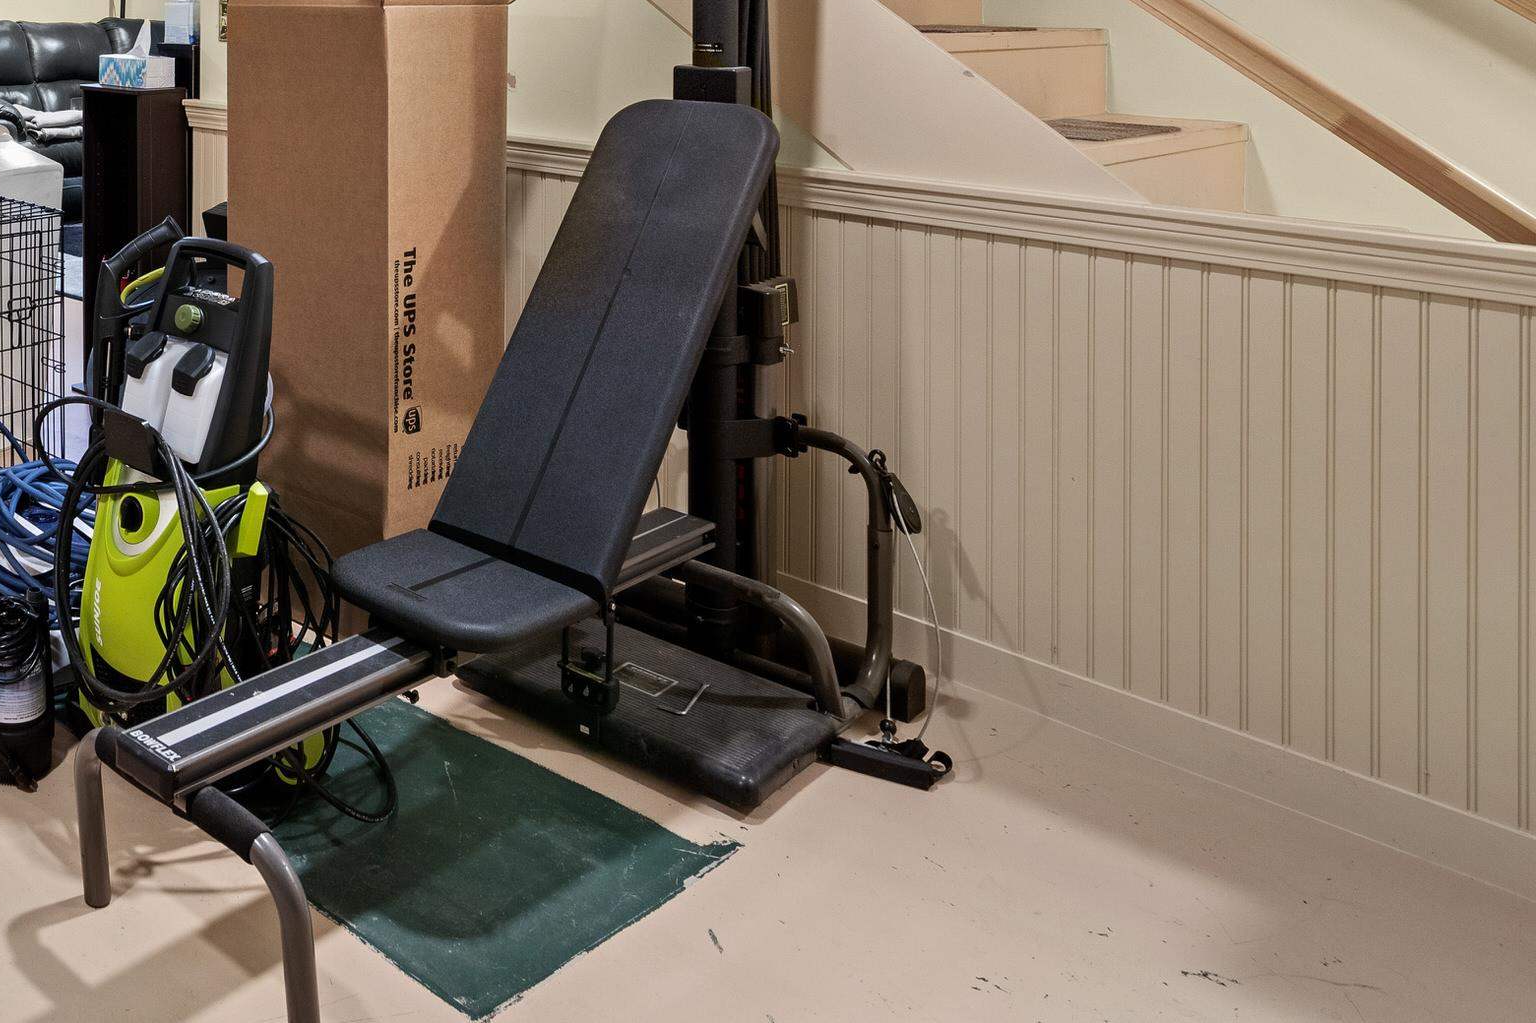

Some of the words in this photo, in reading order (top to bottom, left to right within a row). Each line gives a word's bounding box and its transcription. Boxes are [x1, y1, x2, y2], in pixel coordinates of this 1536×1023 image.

[403, 247, 416, 287] The
[403, 293, 416, 337] UPS
[403, 343, 416, 400] Store
[129, 729, 182, 763] BOWFLEX
